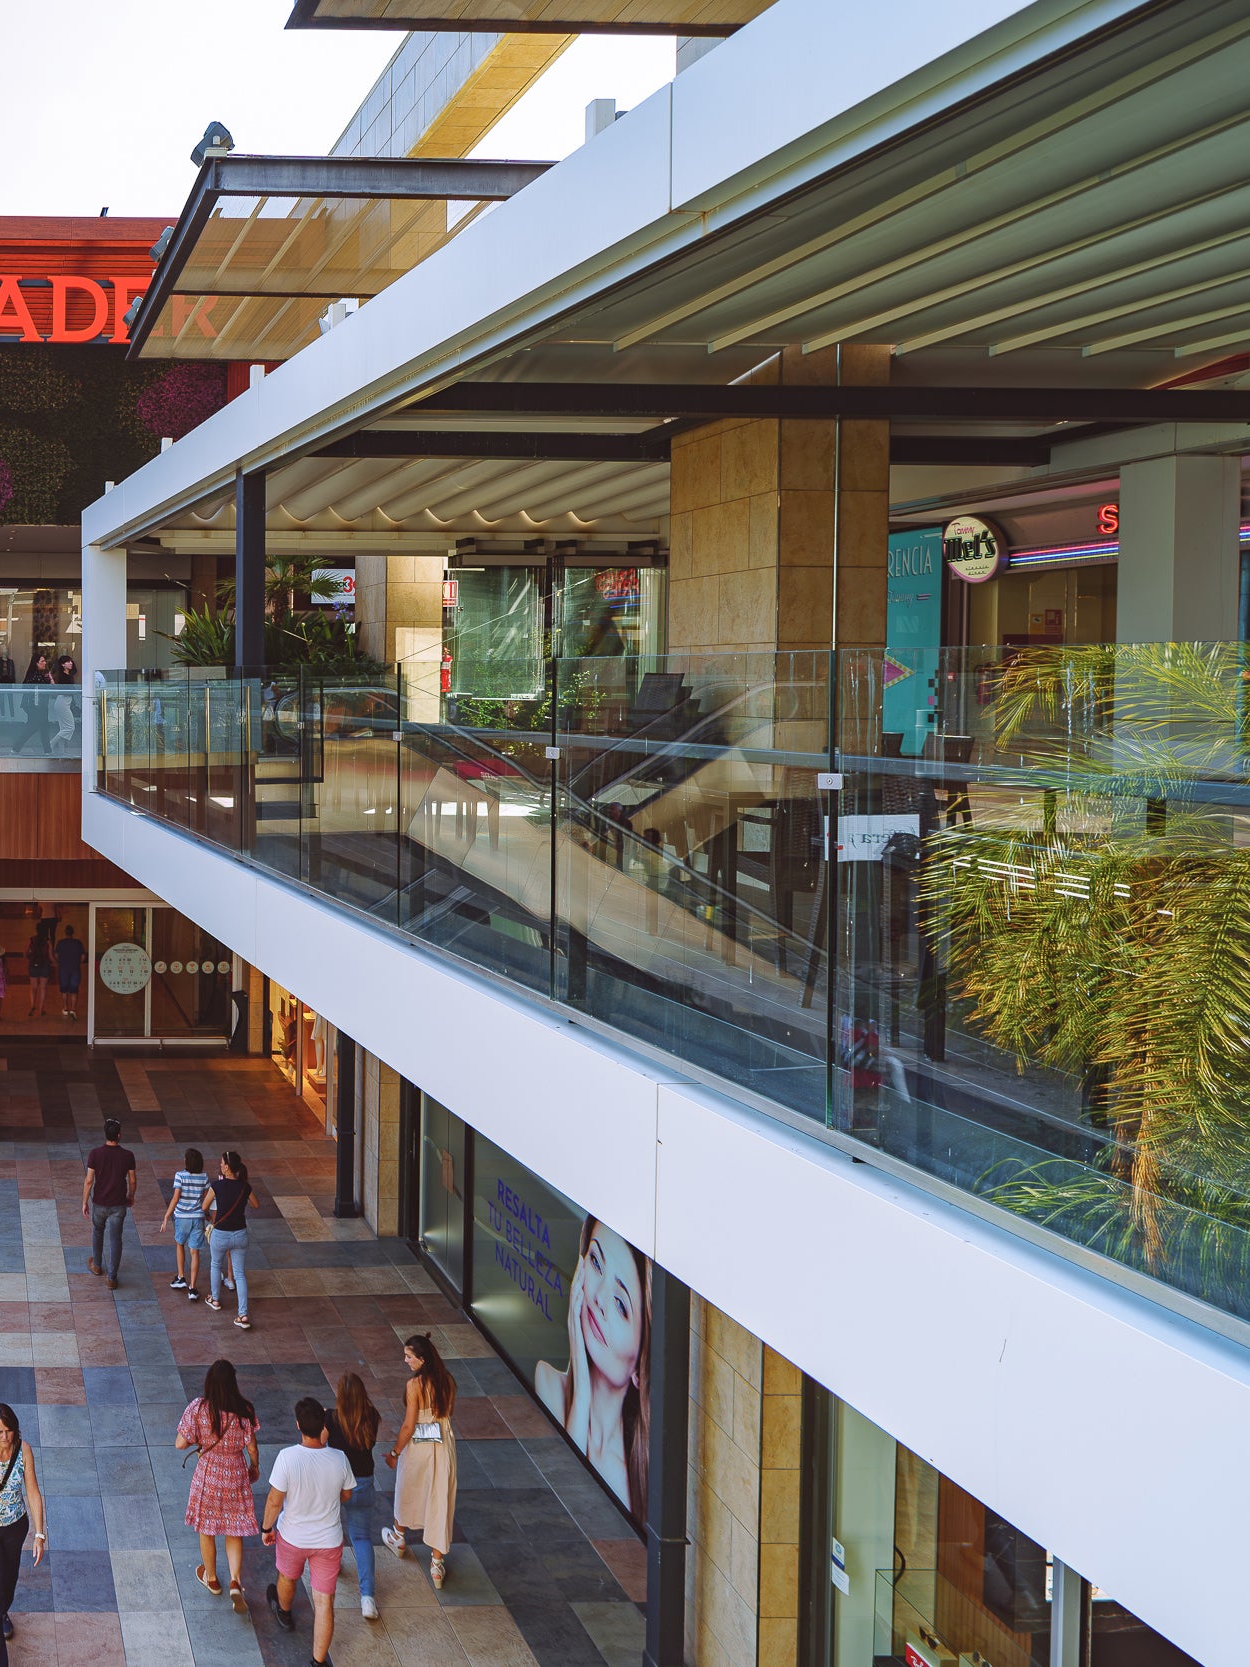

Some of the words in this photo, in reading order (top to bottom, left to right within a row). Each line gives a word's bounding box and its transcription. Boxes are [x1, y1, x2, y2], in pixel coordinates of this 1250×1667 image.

[488, 1200, 502, 1232] TU
[505, 1219, 563, 1297] BELLEZA
[497, 1178, 550, 1250] RESALTA
[495, 1241, 553, 1322] NATURAL
